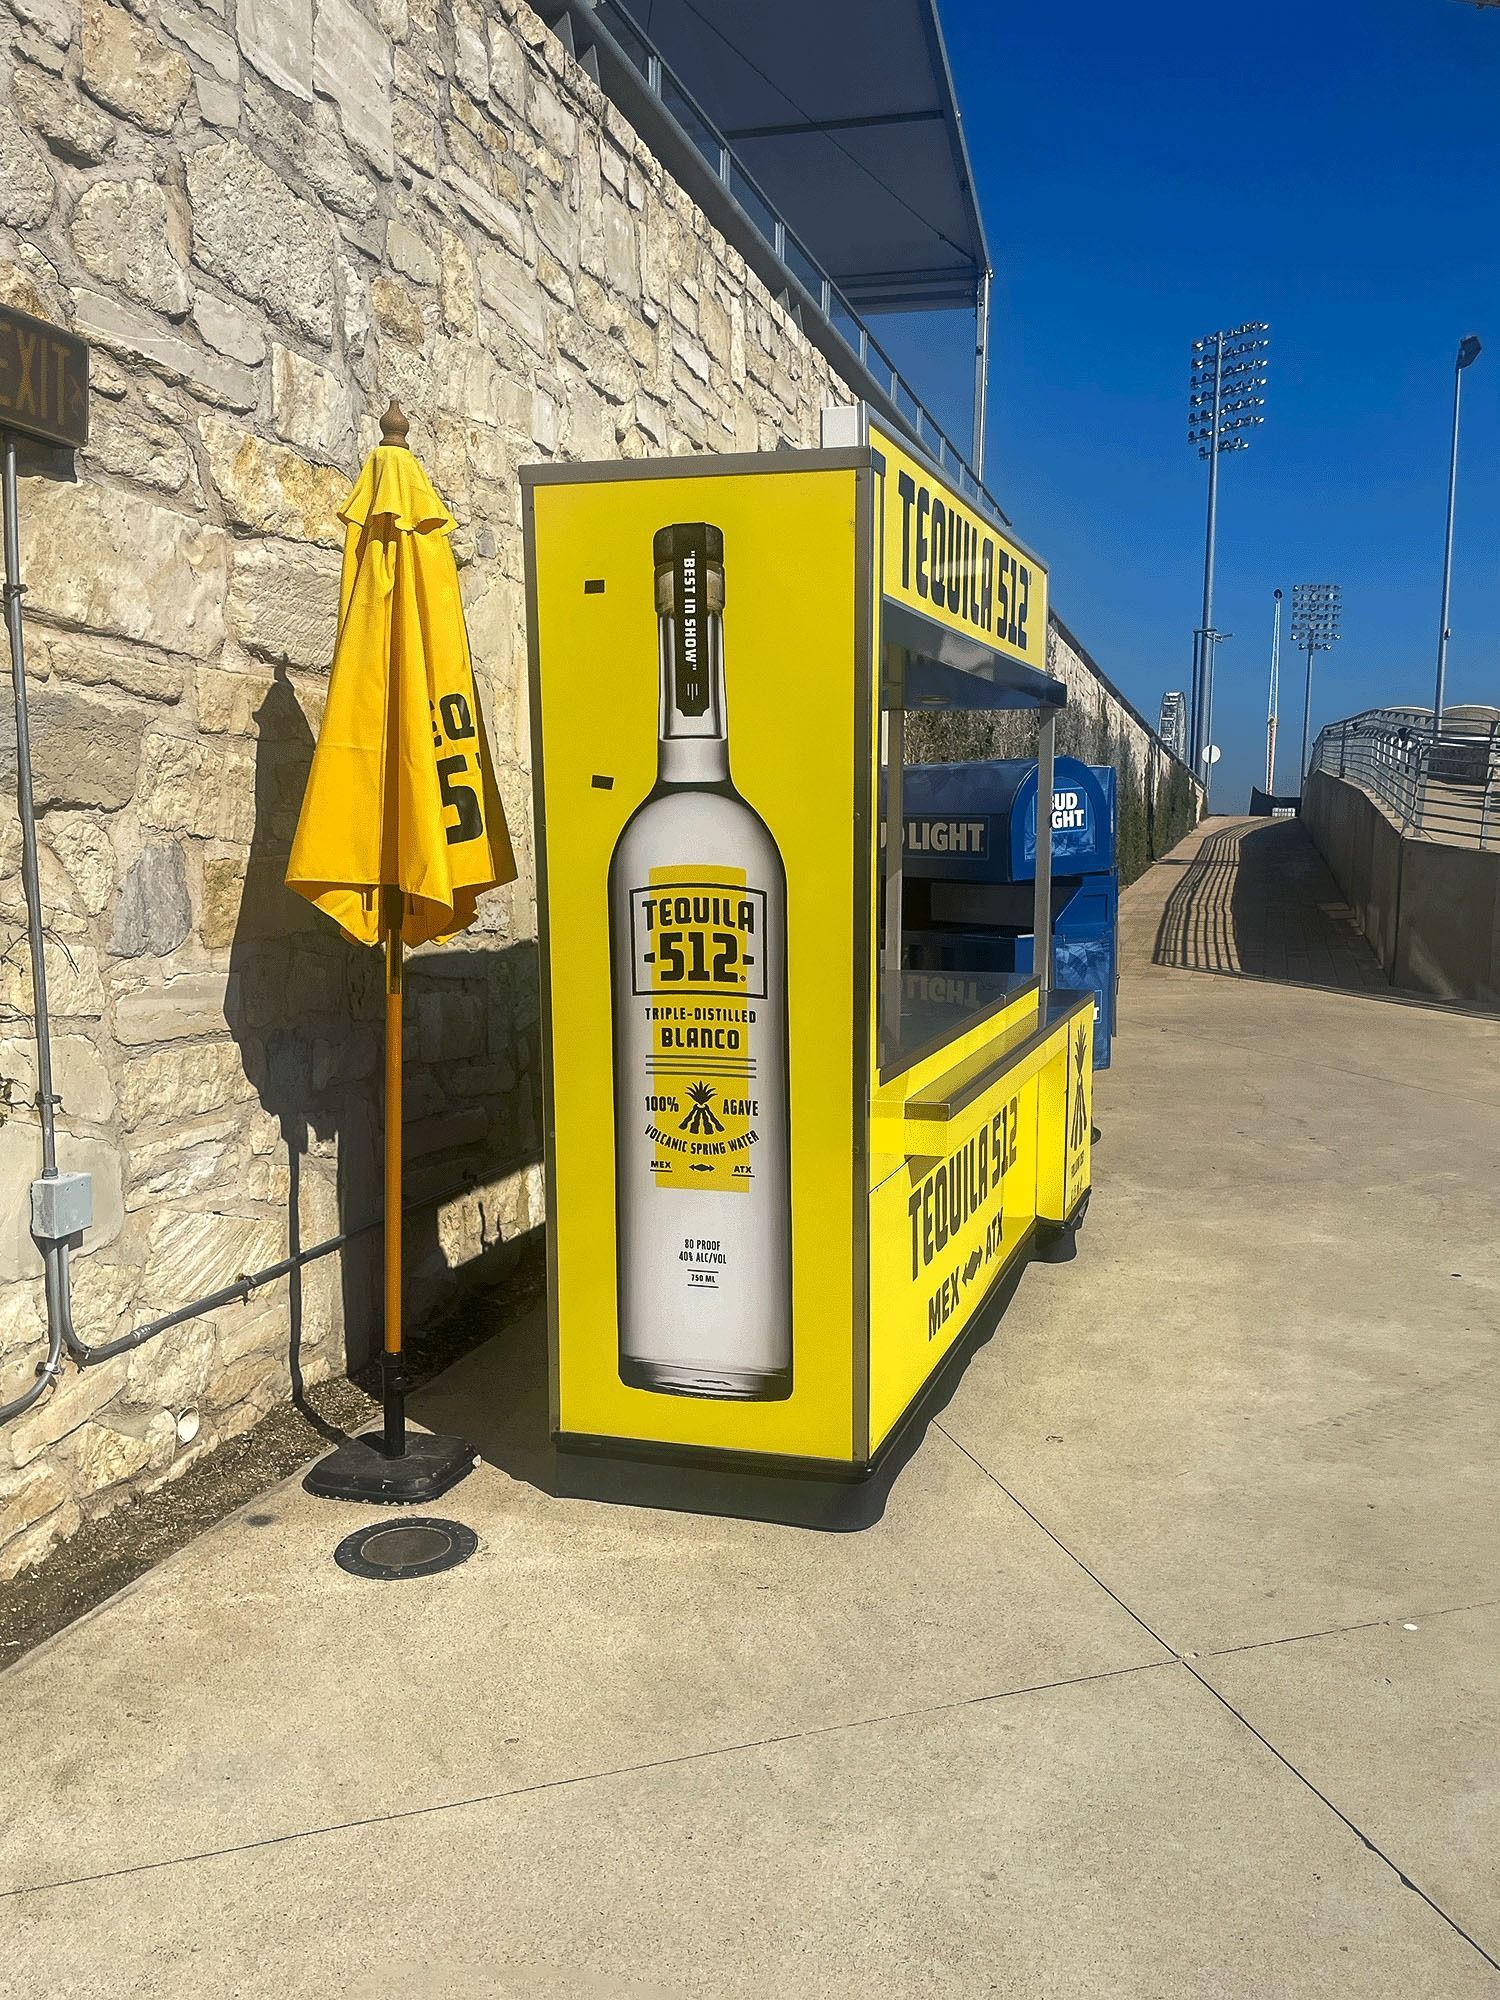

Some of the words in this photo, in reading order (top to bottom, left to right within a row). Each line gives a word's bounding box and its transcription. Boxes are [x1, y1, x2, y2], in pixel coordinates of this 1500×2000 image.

[898, 470, 994, 632] TEQUILA
[684, 598, 697, 614] IN
[1051, 792, 1078, 811] UD
[1051, 809, 1085, 829] GHT
[908, 821, 985, 852] LIGHT
[642, 897, 755, 934] TEQUILA
[645, 1007, 757, 1024] TRIPLE-DISTILLED
[661, 1028, 740, 1050] BLANCO
[645, 1095, 679, 1113] 100%
[723, 1098, 759, 1116] AGAVE
[644, 1123, 688, 1153] VOLCANIC
[690, 1142, 726, 1155] SPRING
[728, 1129, 760, 1152] WATER
[650, 1160, 672, 1169] MEX
[733, 1165, 752, 1174] ATX
[908, 1124, 988, 1282] TEQUILA
[684, 1238, 694, 1249] 80
[696, 1239, 721, 1251] PROOF
[678, 1251, 693, 1262] 40%
[696, 1252, 727, 1265] ALC/VOL
[691, 1273, 703, 1282] 750
[705, 1275, 716, 1283] ML
[928, 1265, 960, 1343] MEX
[985, 1206, 1003, 1265] ATX
